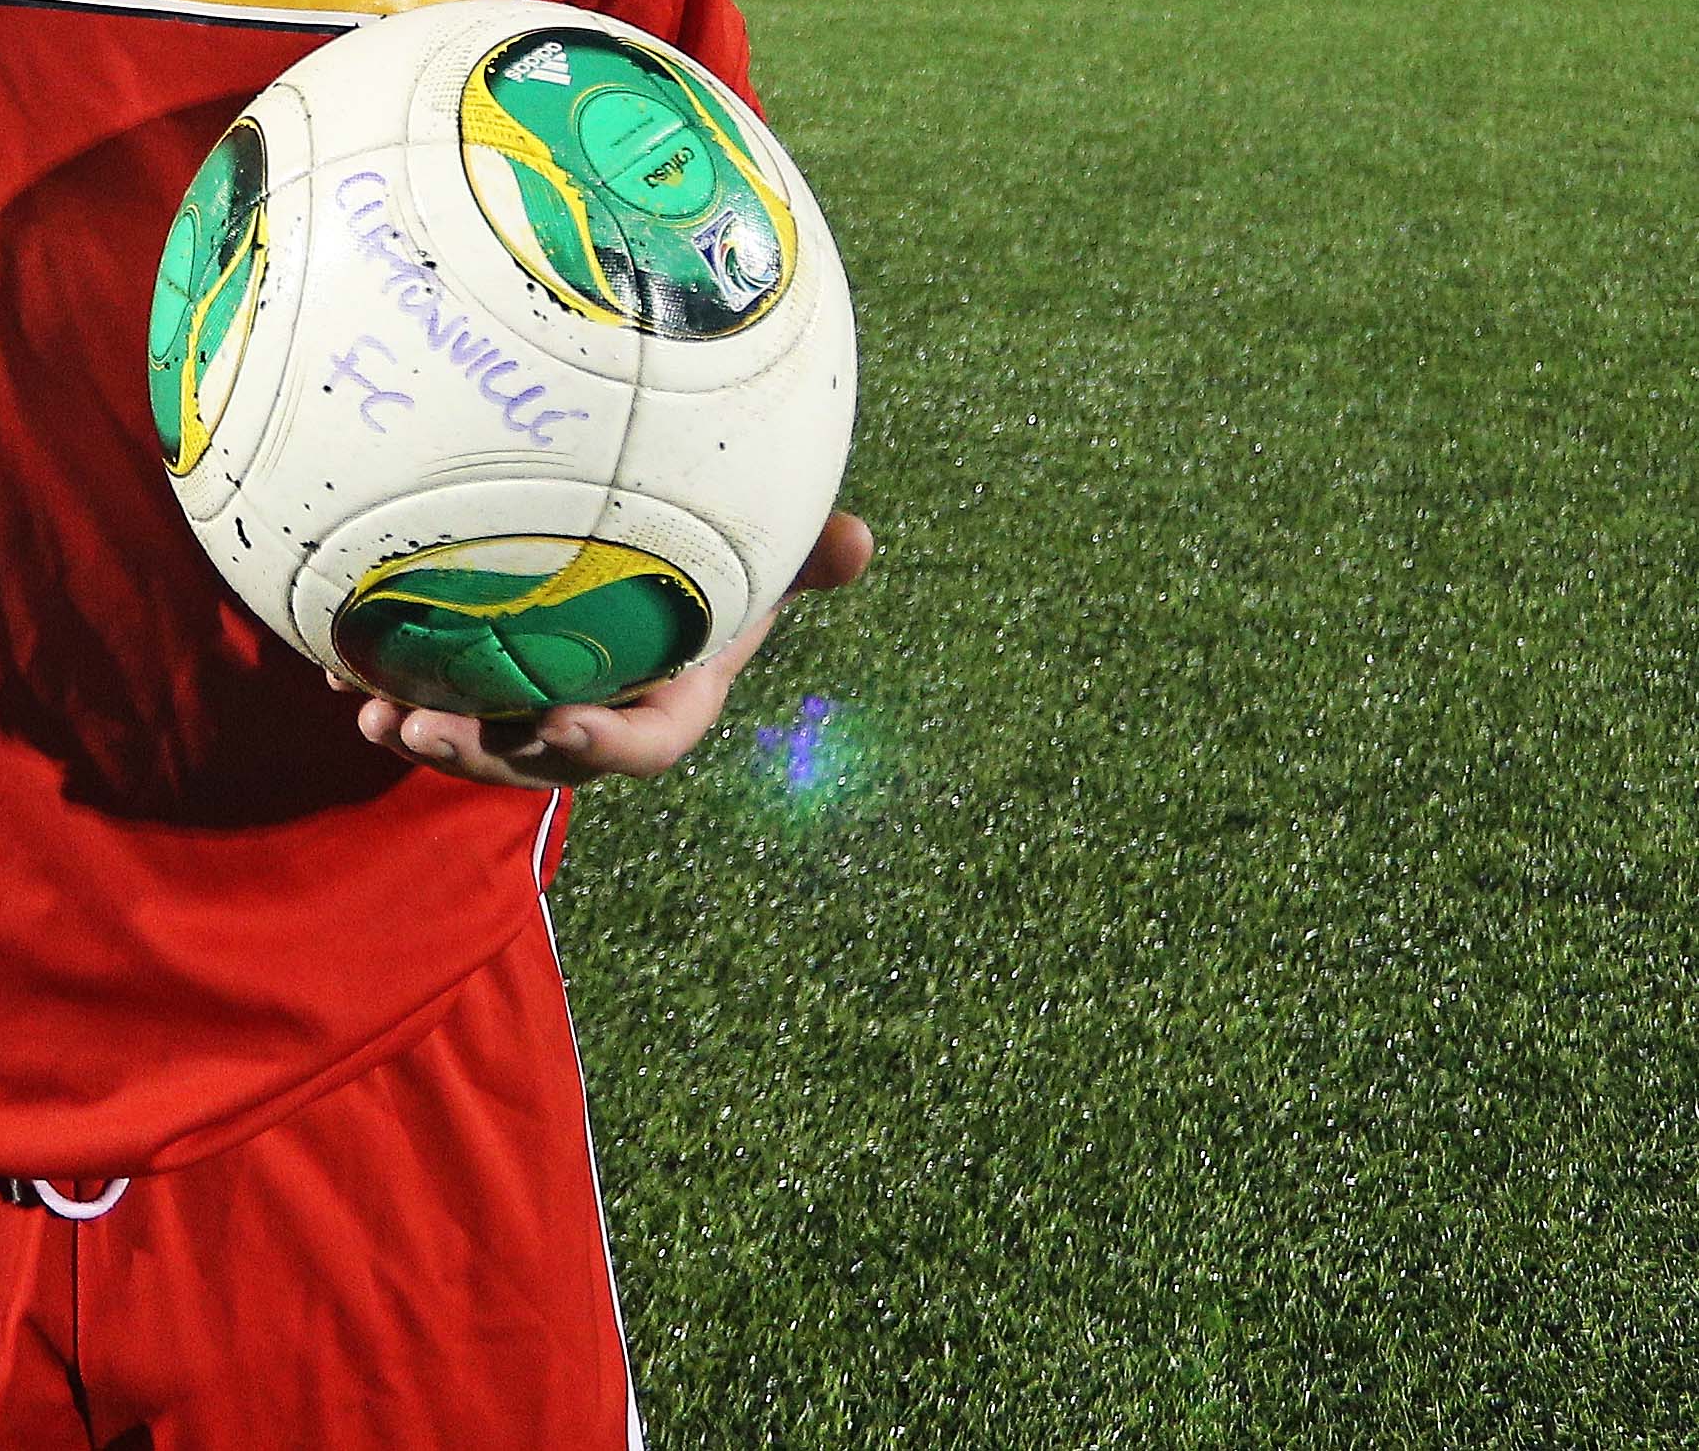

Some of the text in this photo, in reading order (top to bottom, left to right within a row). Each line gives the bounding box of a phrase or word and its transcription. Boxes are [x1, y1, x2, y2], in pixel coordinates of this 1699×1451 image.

[503, 41, 564, 84] adidas
[643, 146, 696, 189] cafusa
[328, 334, 415, 434] FC
